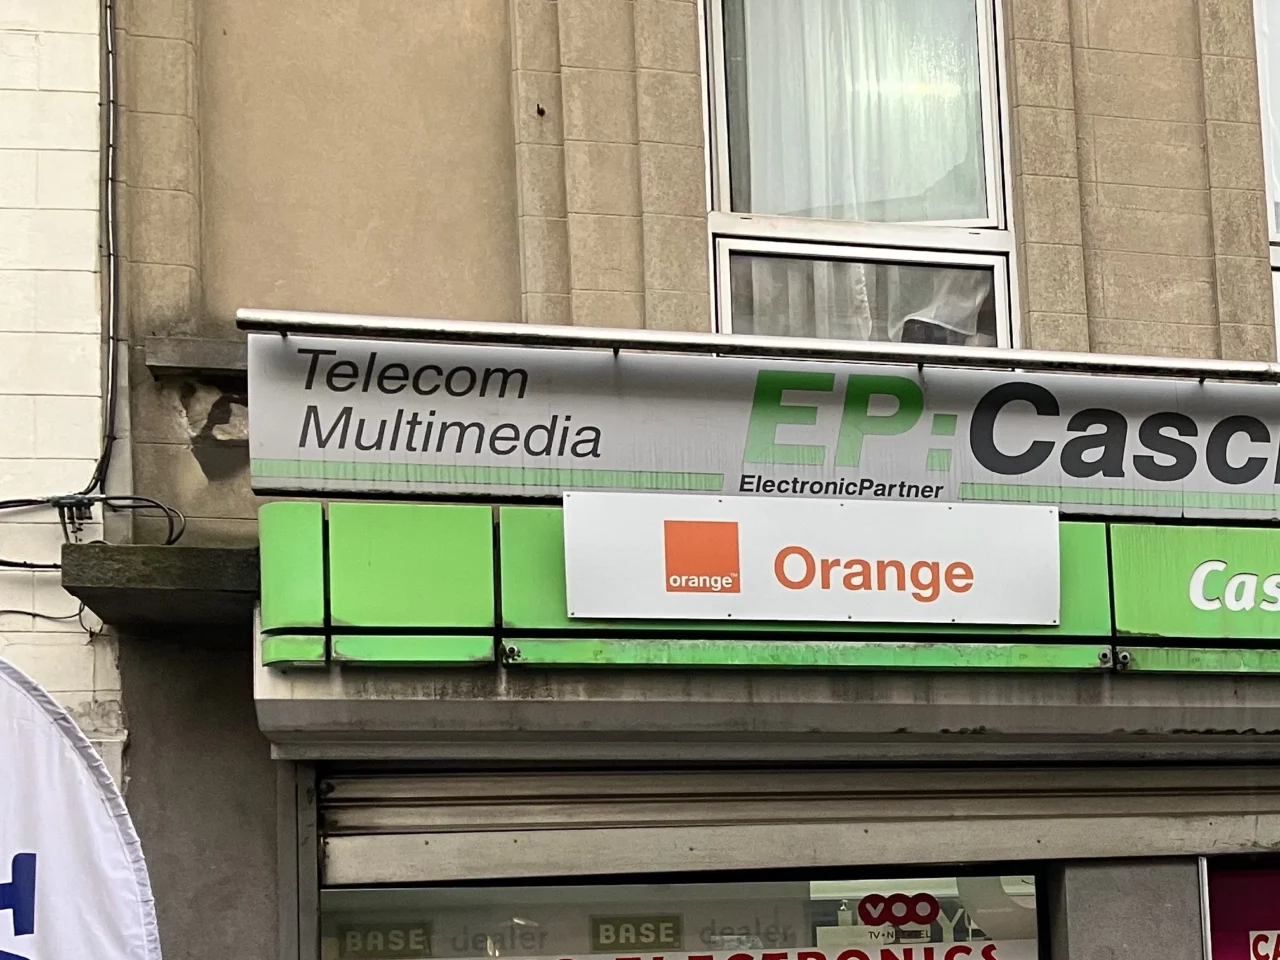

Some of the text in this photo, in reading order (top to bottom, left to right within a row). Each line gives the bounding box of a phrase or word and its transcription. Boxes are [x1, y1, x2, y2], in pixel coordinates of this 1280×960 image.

[296, 348, 529, 399] Telecom
[298, 405, 602, 459] Multimedia
[739, 474, 944, 499] ElectronicPartner
[669, 575, 733, 592] orange
[773, 546, 975, 603] Orange
[345, 928, 425, 951] BASE
[600, 921, 675, 944] BASE
